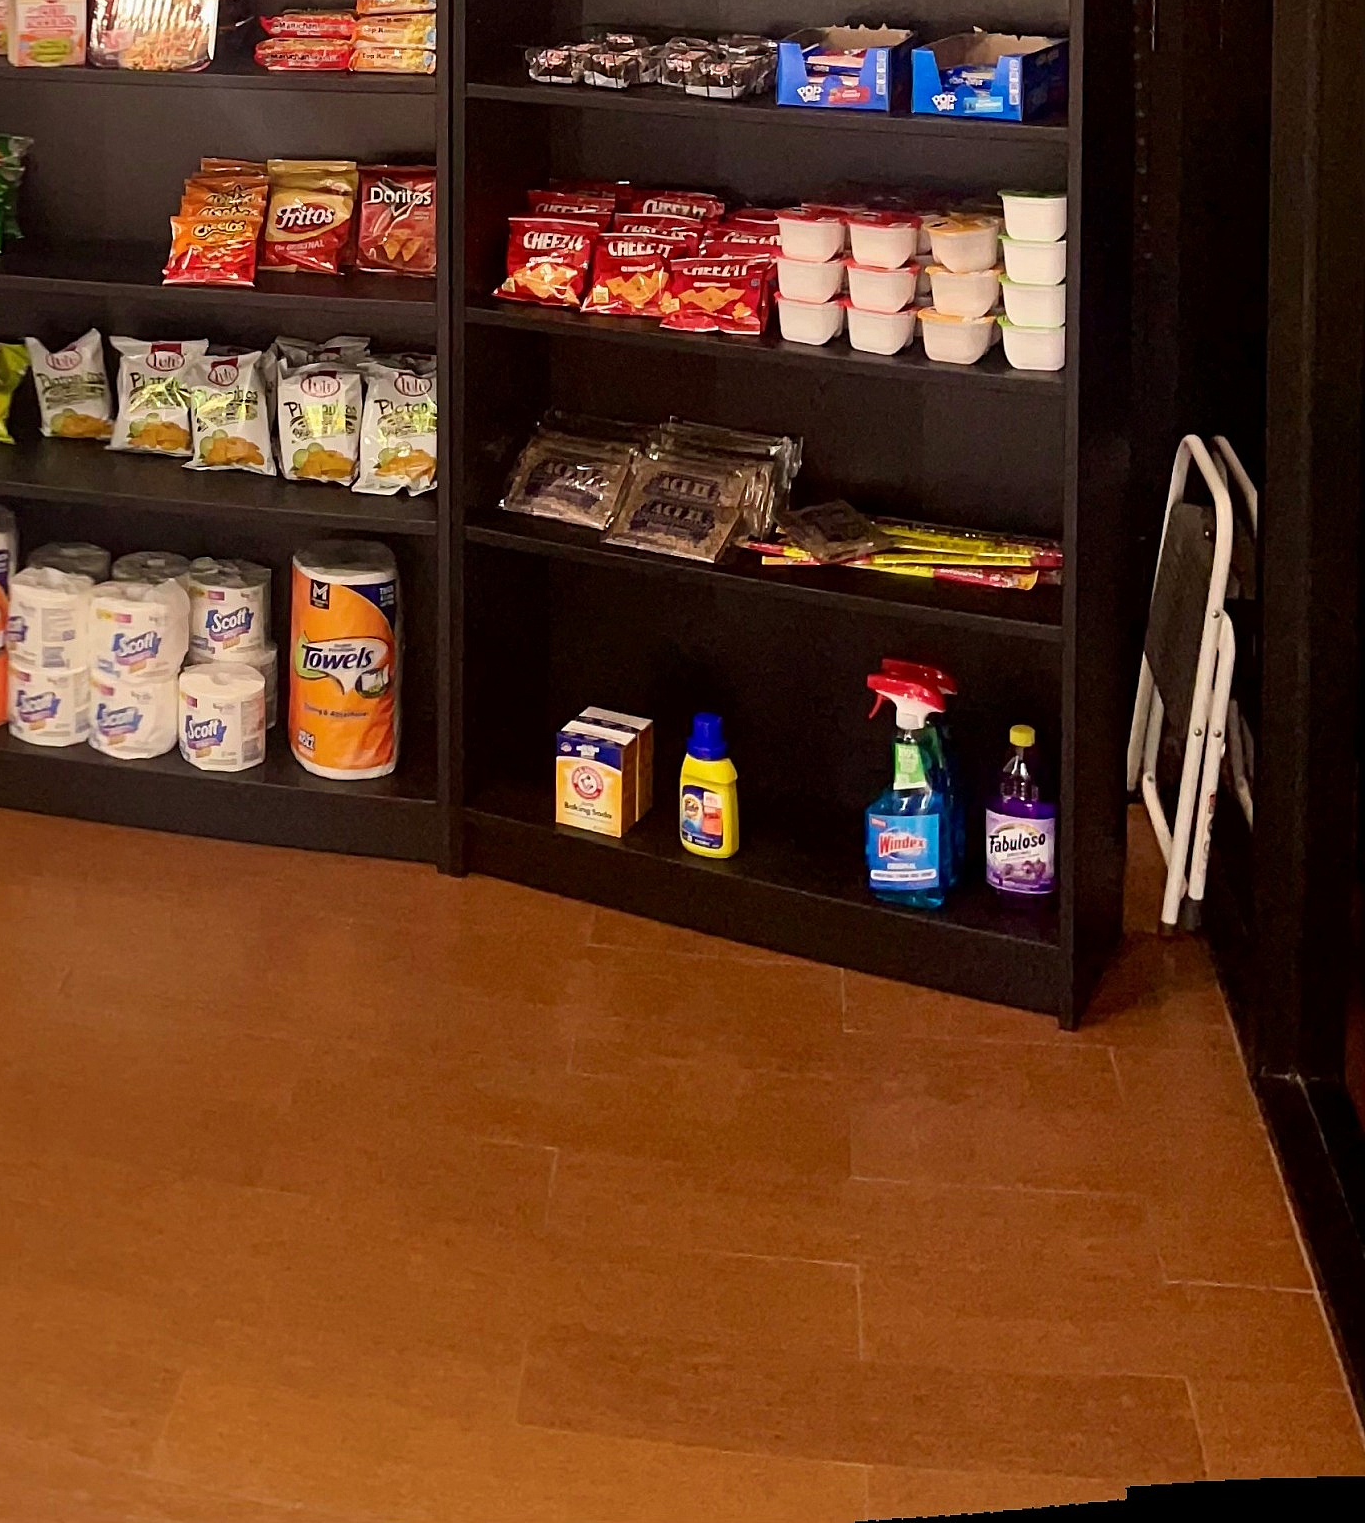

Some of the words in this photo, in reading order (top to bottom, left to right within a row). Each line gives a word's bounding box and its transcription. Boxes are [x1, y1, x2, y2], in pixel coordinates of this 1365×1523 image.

[370, 187, 432, 205] Doritos
[276, 204, 336, 229] Fritos
[211, 607, 247, 633] Scott
[120, 631, 153, 657] Scott
[302, 643, 374, 670] Towels
[187, 717, 220, 740] Scott
[878, 834, 924, 857] Windex
[988, 832, 1047, 855] Fabuloso
